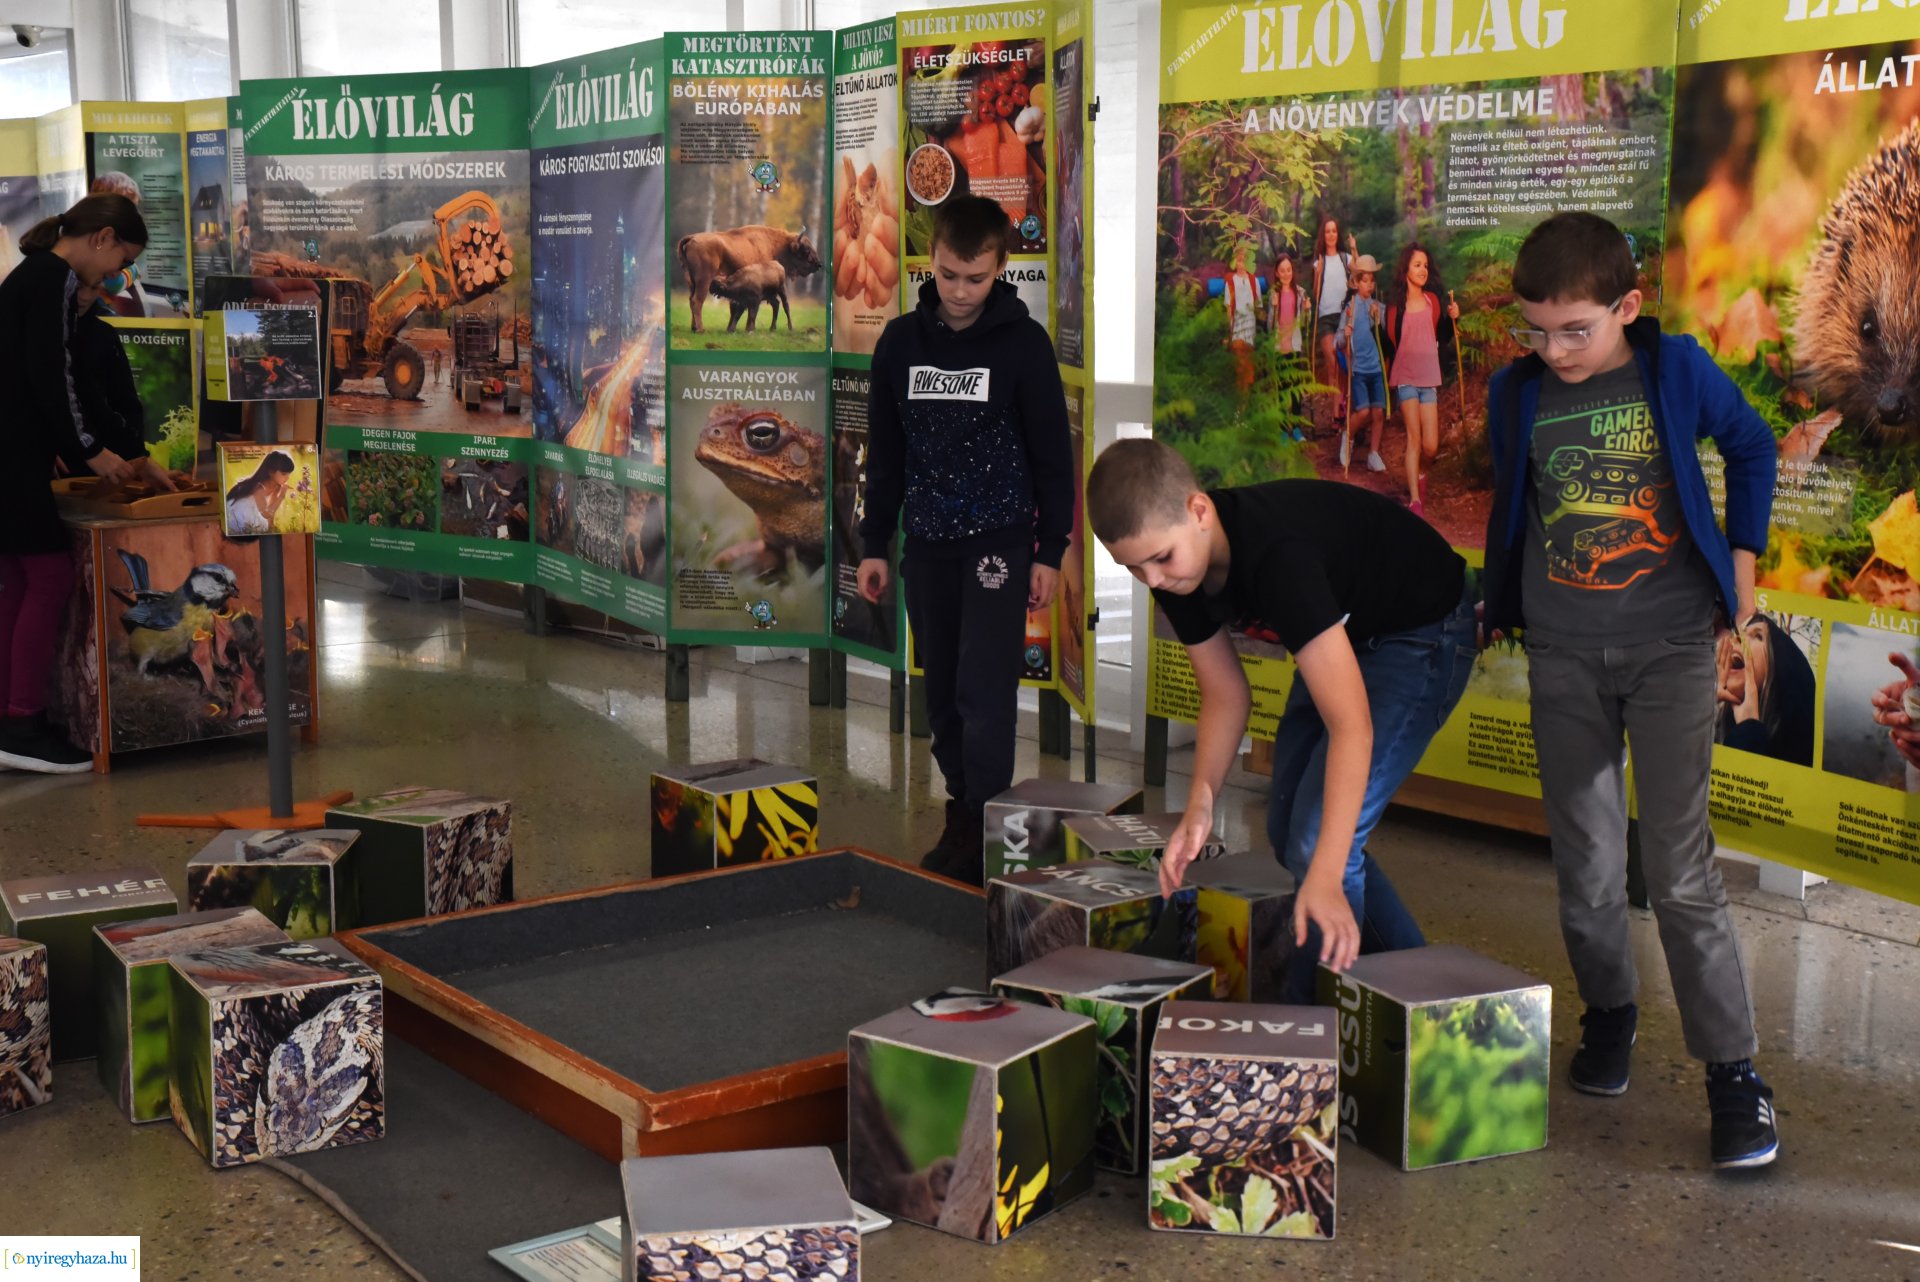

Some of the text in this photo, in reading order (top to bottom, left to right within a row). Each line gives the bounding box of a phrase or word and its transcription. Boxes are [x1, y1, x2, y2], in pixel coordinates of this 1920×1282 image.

[902, 13, 959, 37] MIÉRT
[964, 8, 1046, 33] FONTOS?
[683, 36, 814, 54] MEGTÖRTÉNT
[843, 23, 894, 50] MILYEN LESZ
[1167, 2, 1239, 77] FENNTARTHATÓ
[672, 57, 826, 75] KATASZTRÓFÁK
[851, 45, 884, 71] A JÖVŐ?
[914, 48, 1033, 69] ÉLETSZÜKSÉGLET
[673, 80, 824, 98] BÖLÉNY KIHALÁS
[836, 72, 898, 96] ELTŰNŐ ÁLLATOK
[554, 57, 654, 130] ÉLŐVILÁG
[291, 83, 475, 140] ÉLŐVILÁG
[695, 100, 801, 116] EURÓPÁBAN
[1244, 86, 1555, 132] A NÖVÉNYEK VÉDELME
[109, 135, 157, 145] A TISZTA
[1450, 124, 1607, 141] Növények nélkül nem létezhetünk.
[103, 145, 165, 158] LEVEGŐÉRT
[1450, 143, 1488, 153] Termelik
[1502, 141, 1529, 151] éltető
[1531, 139, 1569, 151] oxigént,
[1571, 136, 1617, 149] táplálnak
[1619, 134, 1657, 146] embert,
[539, 156, 567, 176] KÁROS
[568, 146, 621, 174] FOGYASZTÓI
[1449, 147, 1656, 166] állatot, gyönyörködtetnek és megnyugtatnak
[265, 161, 315, 182] KÁROS
[320, 160, 404, 181] TERMELÉSI
[409, 160, 507, 180] MÓDSZEREK
[1449, 159, 1650, 178] bennünket. Minden egyes fa, minden szál fű
[1448, 174, 1633, 190] és minden virág érték, egy-egy építőkő a
[1447, 188, 1618, 202] természet nagy egészében. Védelmük
[1446, 199, 1634, 214] nemcsak kötelességünk, hanem alapvető
[1446, 216, 1500, 226] érdekünk is.
[133, 333, 185, 346] OXIGÉNT!
[698, 370, 798, 385] VARANGYOK
[832, 376, 859, 394] ELTŰNŐ
[912, 370, 984, 397] AWESOME
[682, 385, 816, 402] AUSZTRÁLIÁBAN
[362, 428, 417, 441] IDEGEN FAJOK
[473, 435, 496, 446] IPARI
[363, 440, 416, 452] MEGJELENÉSE
[461, 446, 509, 458] SZENNYEZÉS
[1785, 459, 1829, 475] le tudjuk
[1796, 475, 1853, 491] búvóhelyet,
[1816, 491, 1847, 504] nekik.
[1807, 504, 1835, 517] mivel
[992, 555, 1009, 573] YORK
[1470, 712, 1511, 727] Ismerd meg
[1476, 723, 1514, 736] vadvirágok
[1469, 732, 1517, 747] védett fajokat
[1468, 749, 1507, 763] büntetendő
[1469, 740, 1476, 748] Ez
[1478, 742, 1494, 751] azon
[1517, 748, 1534, 760] hogy
[1468, 759, 1497, 771] érdemes
[1711, 768, 1769, 791] alkan közlekedj!
[1717, 779, 1784, 805] nagy része rosszul
[1716, 789, 1794, 819] elhagyja az élőhelyét.
[1737, 807, 1762, 820] állatok
[1763, 814, 1785, 828] életét
[1838, 801, 1906, 826] Sok állatnak van
[1837, 822, 1880, 842] állatmentő
[1838, 810, 1917, 841] Önkéntesként részt
[1835, 846, 1880, 866] segítése is.
[1836, 834, 1909, 862] tavaszi szaporodó
